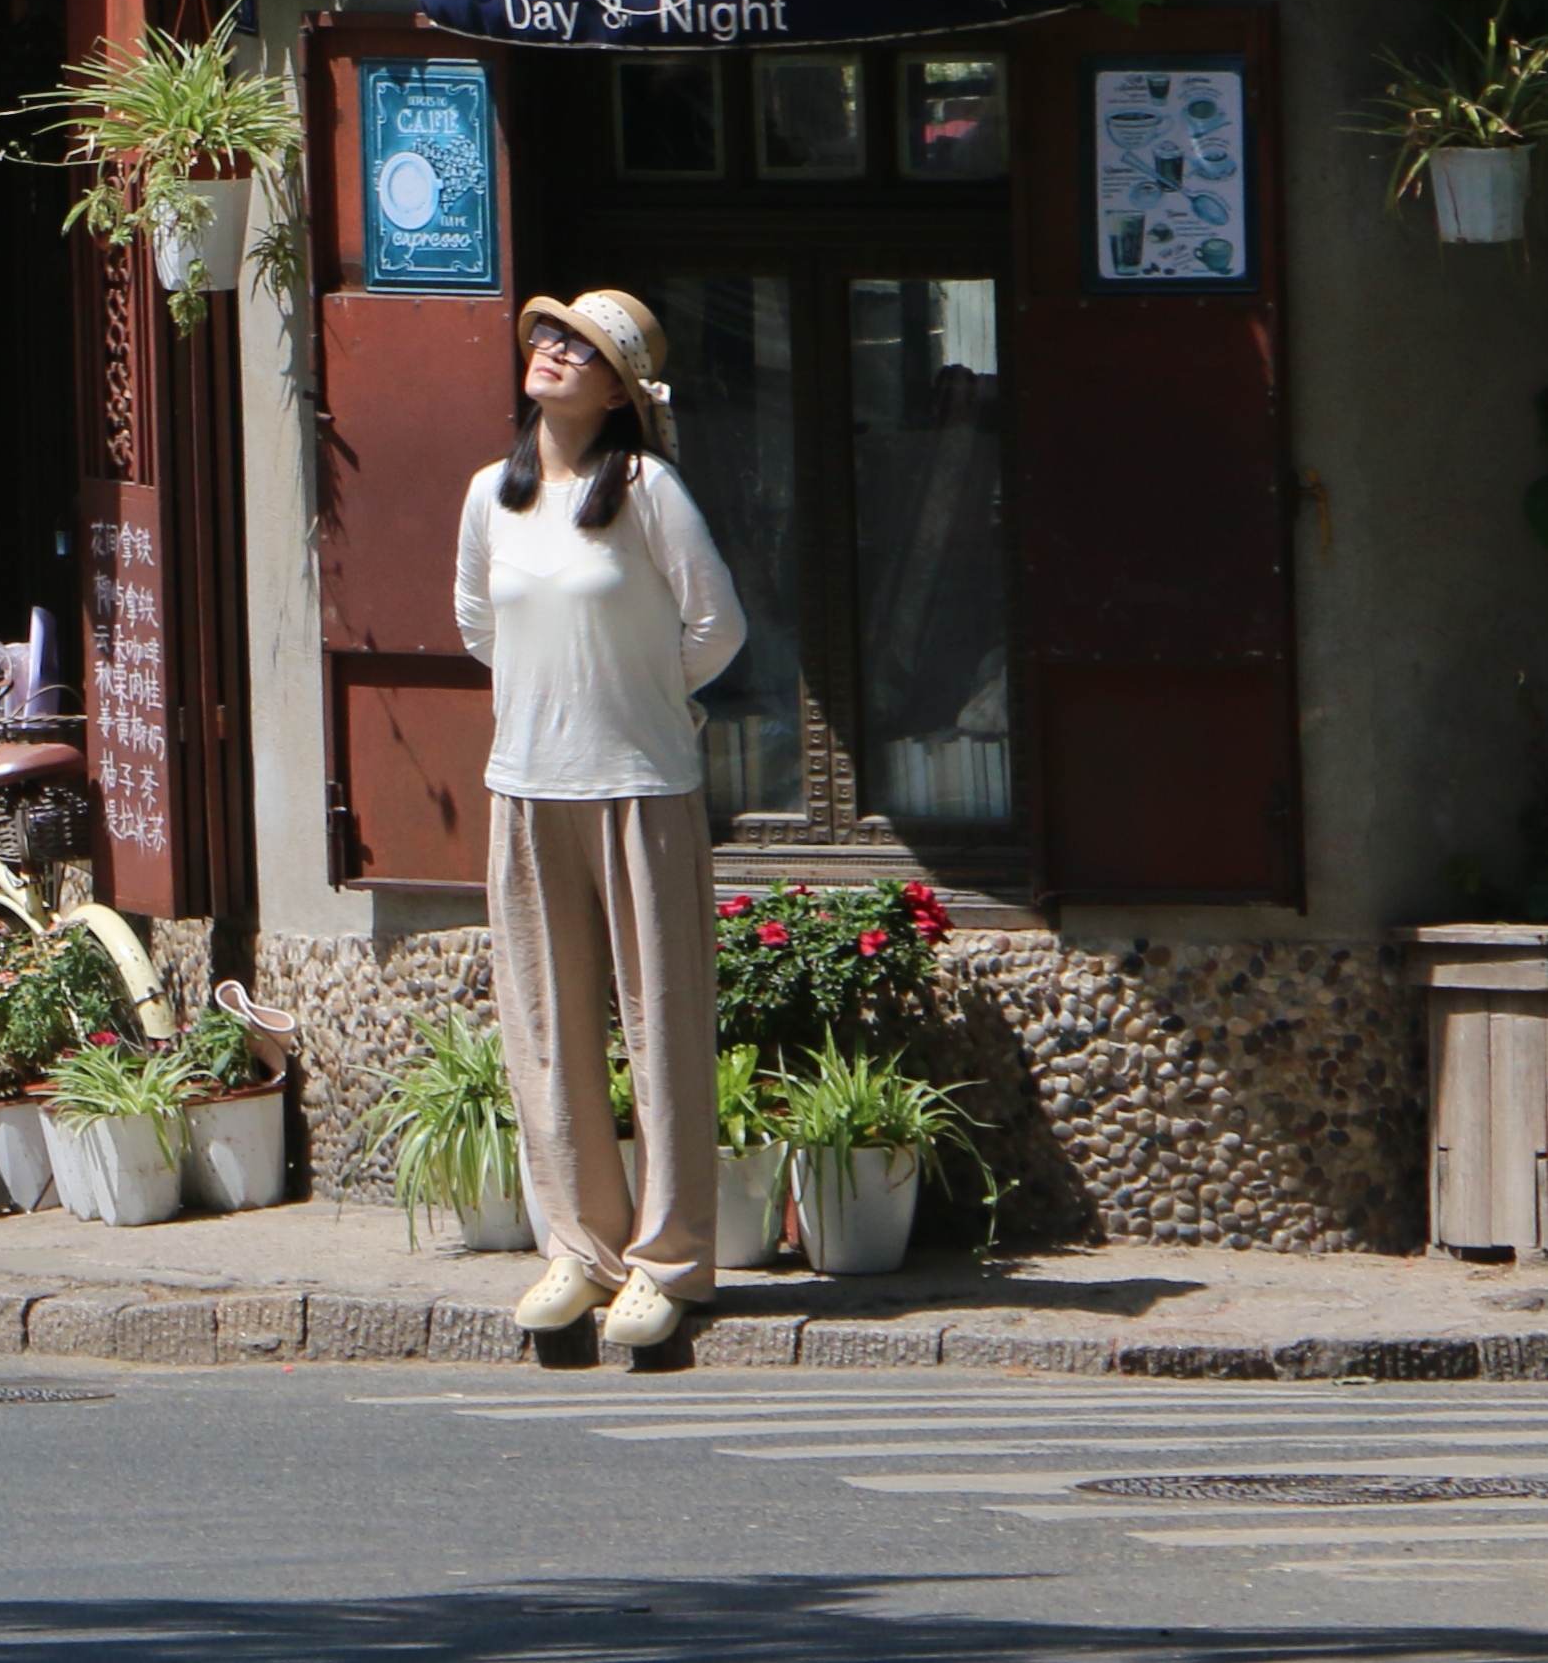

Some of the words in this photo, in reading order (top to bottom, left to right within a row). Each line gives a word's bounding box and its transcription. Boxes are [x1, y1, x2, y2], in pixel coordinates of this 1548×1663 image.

[397, 104, 460, 134] CAFÉ
[99, 748, 161, 812] 柚子茶
